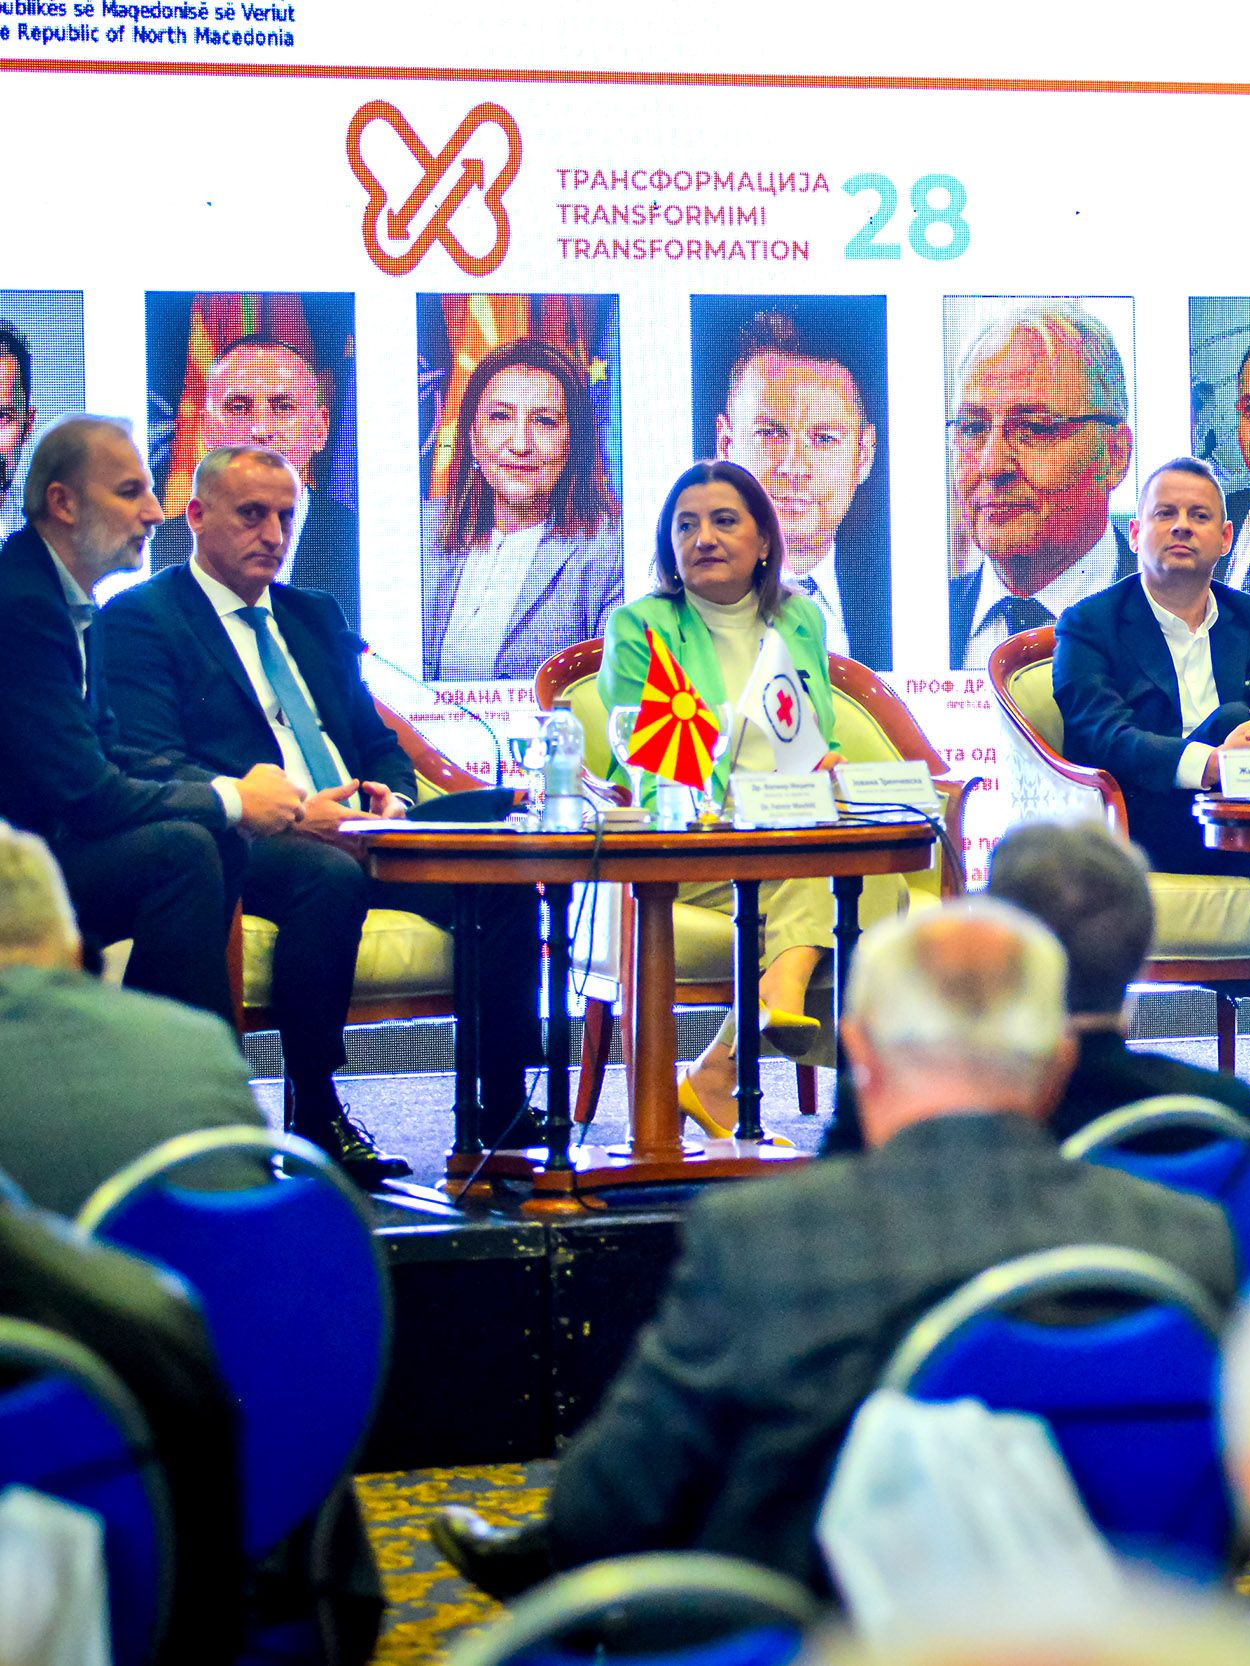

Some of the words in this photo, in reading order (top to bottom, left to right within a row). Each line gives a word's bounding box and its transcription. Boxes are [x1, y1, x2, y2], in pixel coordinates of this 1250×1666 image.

[102, 0, 209, 22] Maqedonisë
[215, 2, 236, 20] së
[241, 3, 295, 22] Veriut
[18, 22, 99, 45] Republic
[106, 25, 125, 42] of
[133, 26, 187, 44] North
[194, 26, 294, 47] Macedonia
[556, 168, 830, 197] ТРАНСФОРМАЦИЈА
[556, 203, 767, 226] TRANSFORMIMI
[840, 172, 972, 261] 28
[556, 237, 809, 261] TRANSFORMATION
